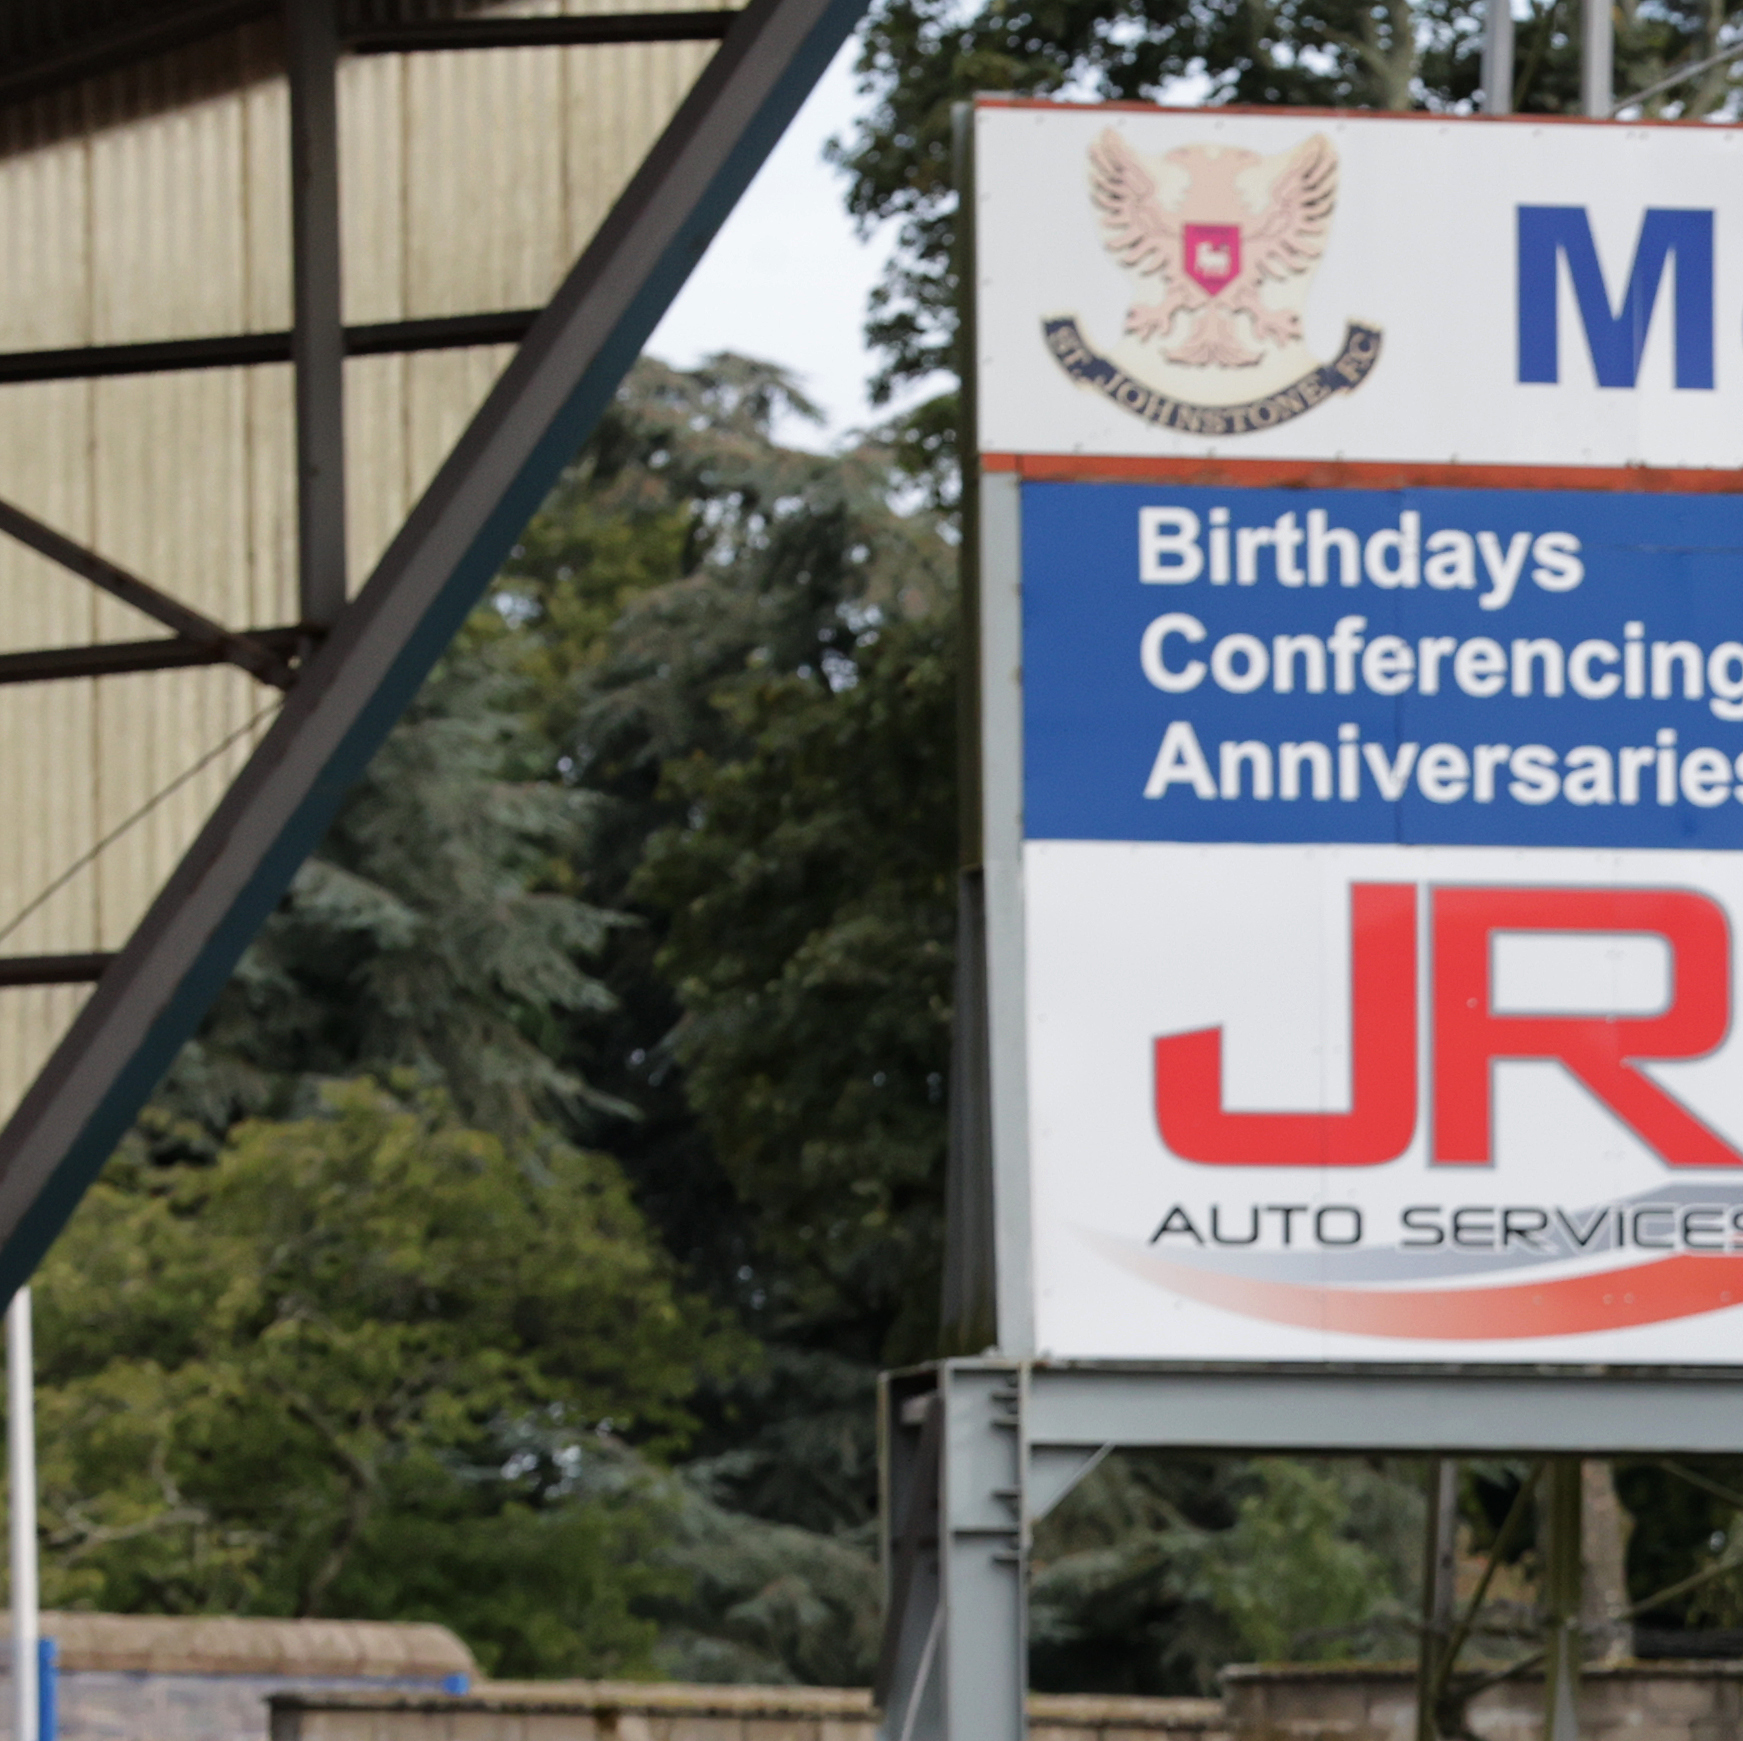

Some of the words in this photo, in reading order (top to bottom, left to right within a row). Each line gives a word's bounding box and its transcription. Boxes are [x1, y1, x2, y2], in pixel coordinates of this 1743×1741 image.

[1098, 374, 1331, 435] JOHNSTONE
[1138, 505, 1585, 609] Birthdays
[1149, 1203, 1364, 1248] AUTO
